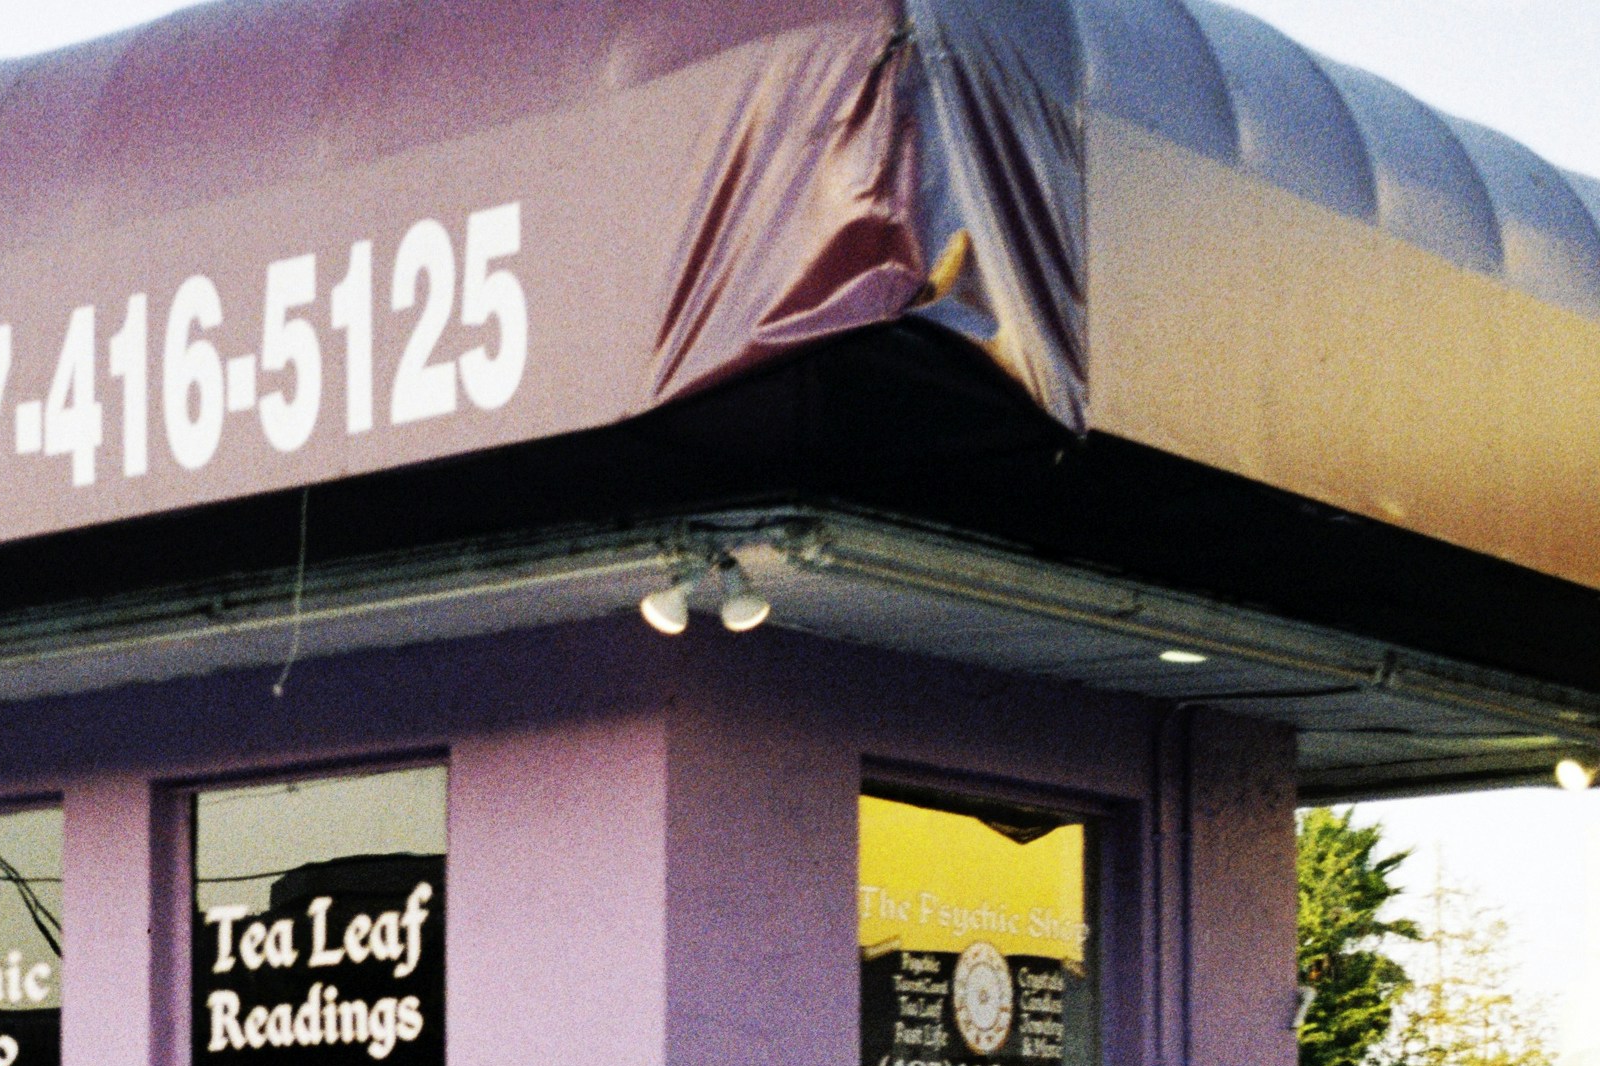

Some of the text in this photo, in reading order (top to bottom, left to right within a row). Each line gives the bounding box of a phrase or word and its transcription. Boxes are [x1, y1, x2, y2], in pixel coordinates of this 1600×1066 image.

[204, 881, 433, 979] Tea Leaf
[859, 885, 911, 922] The
[919, 891, 1021, 937] Psychic
[206, 981, 424, 1060] Readings
